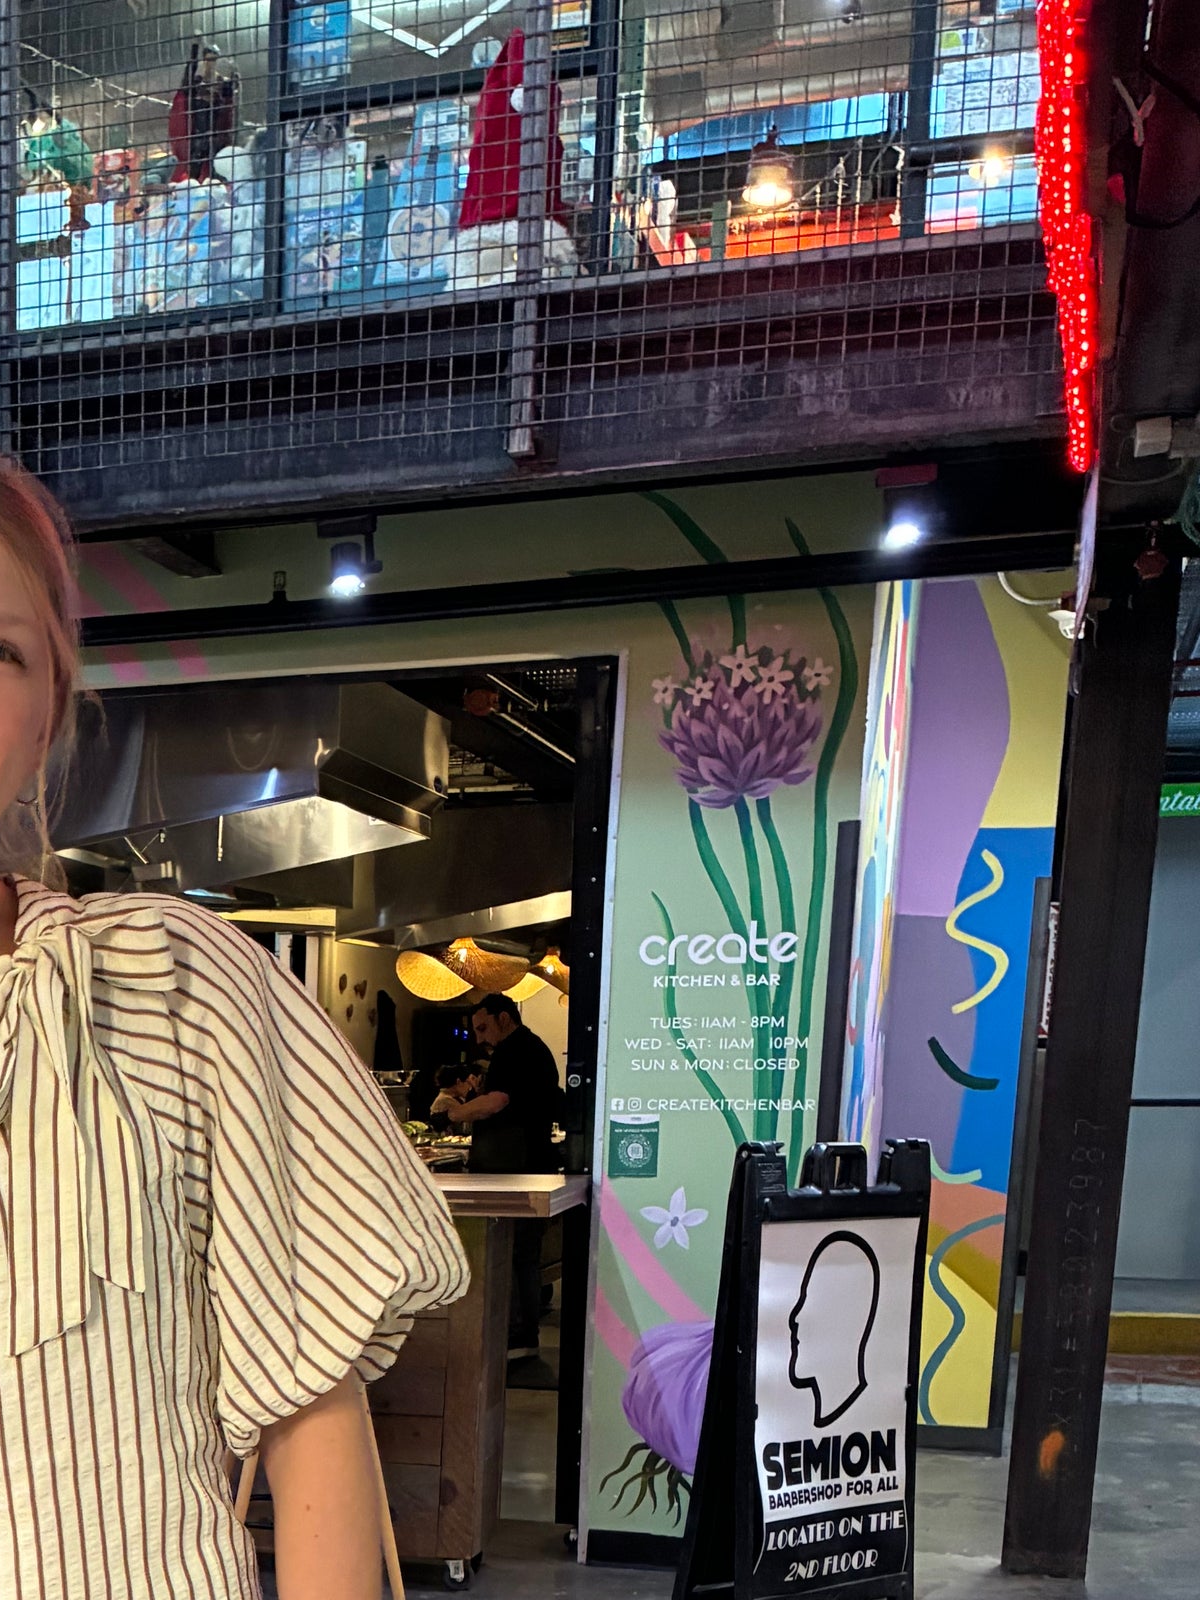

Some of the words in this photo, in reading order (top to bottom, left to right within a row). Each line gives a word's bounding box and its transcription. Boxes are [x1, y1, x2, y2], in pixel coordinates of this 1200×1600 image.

[639, 920, 799, 966] create
[653, 974, 726, 988] KITCHEN
[730, 974, 741, 987] &
[745, 973, 781, 987] BAR
[750, 1016, 785, 1028] 8PM
[625, 1038, 662, 1050] WED
[675, 1038, 711, 1050] SAT:
[719, 1038, 754, 1049] 11AM
[769, 1037, 809, 1049] 10PM
[631, 1059, 665, 1071] SUN
[670, 1059, 679, 1070] &
[685, 1059, 730, 1071] MON:
[733, 1058, 800, 1070] CLOSED
[647, 1098, 816, 1111] CREATEKITCHENBAR
[762, 1429, 897, 1490] SEMION
[768, 1483, 843, 1510] BARBERSHOP
[846, 1479, 873, 1496] FOR
[876, 1476, 899, 1493] ALL
[767, 1520, 835, 1551] LOCATED
[838, 1515, 864, 1537] ON
[868, 1509, 905, 1533] THE
[784, 1559, 819, 1582] 2ND
[822, 1549, 878, 1577] FLOOR
